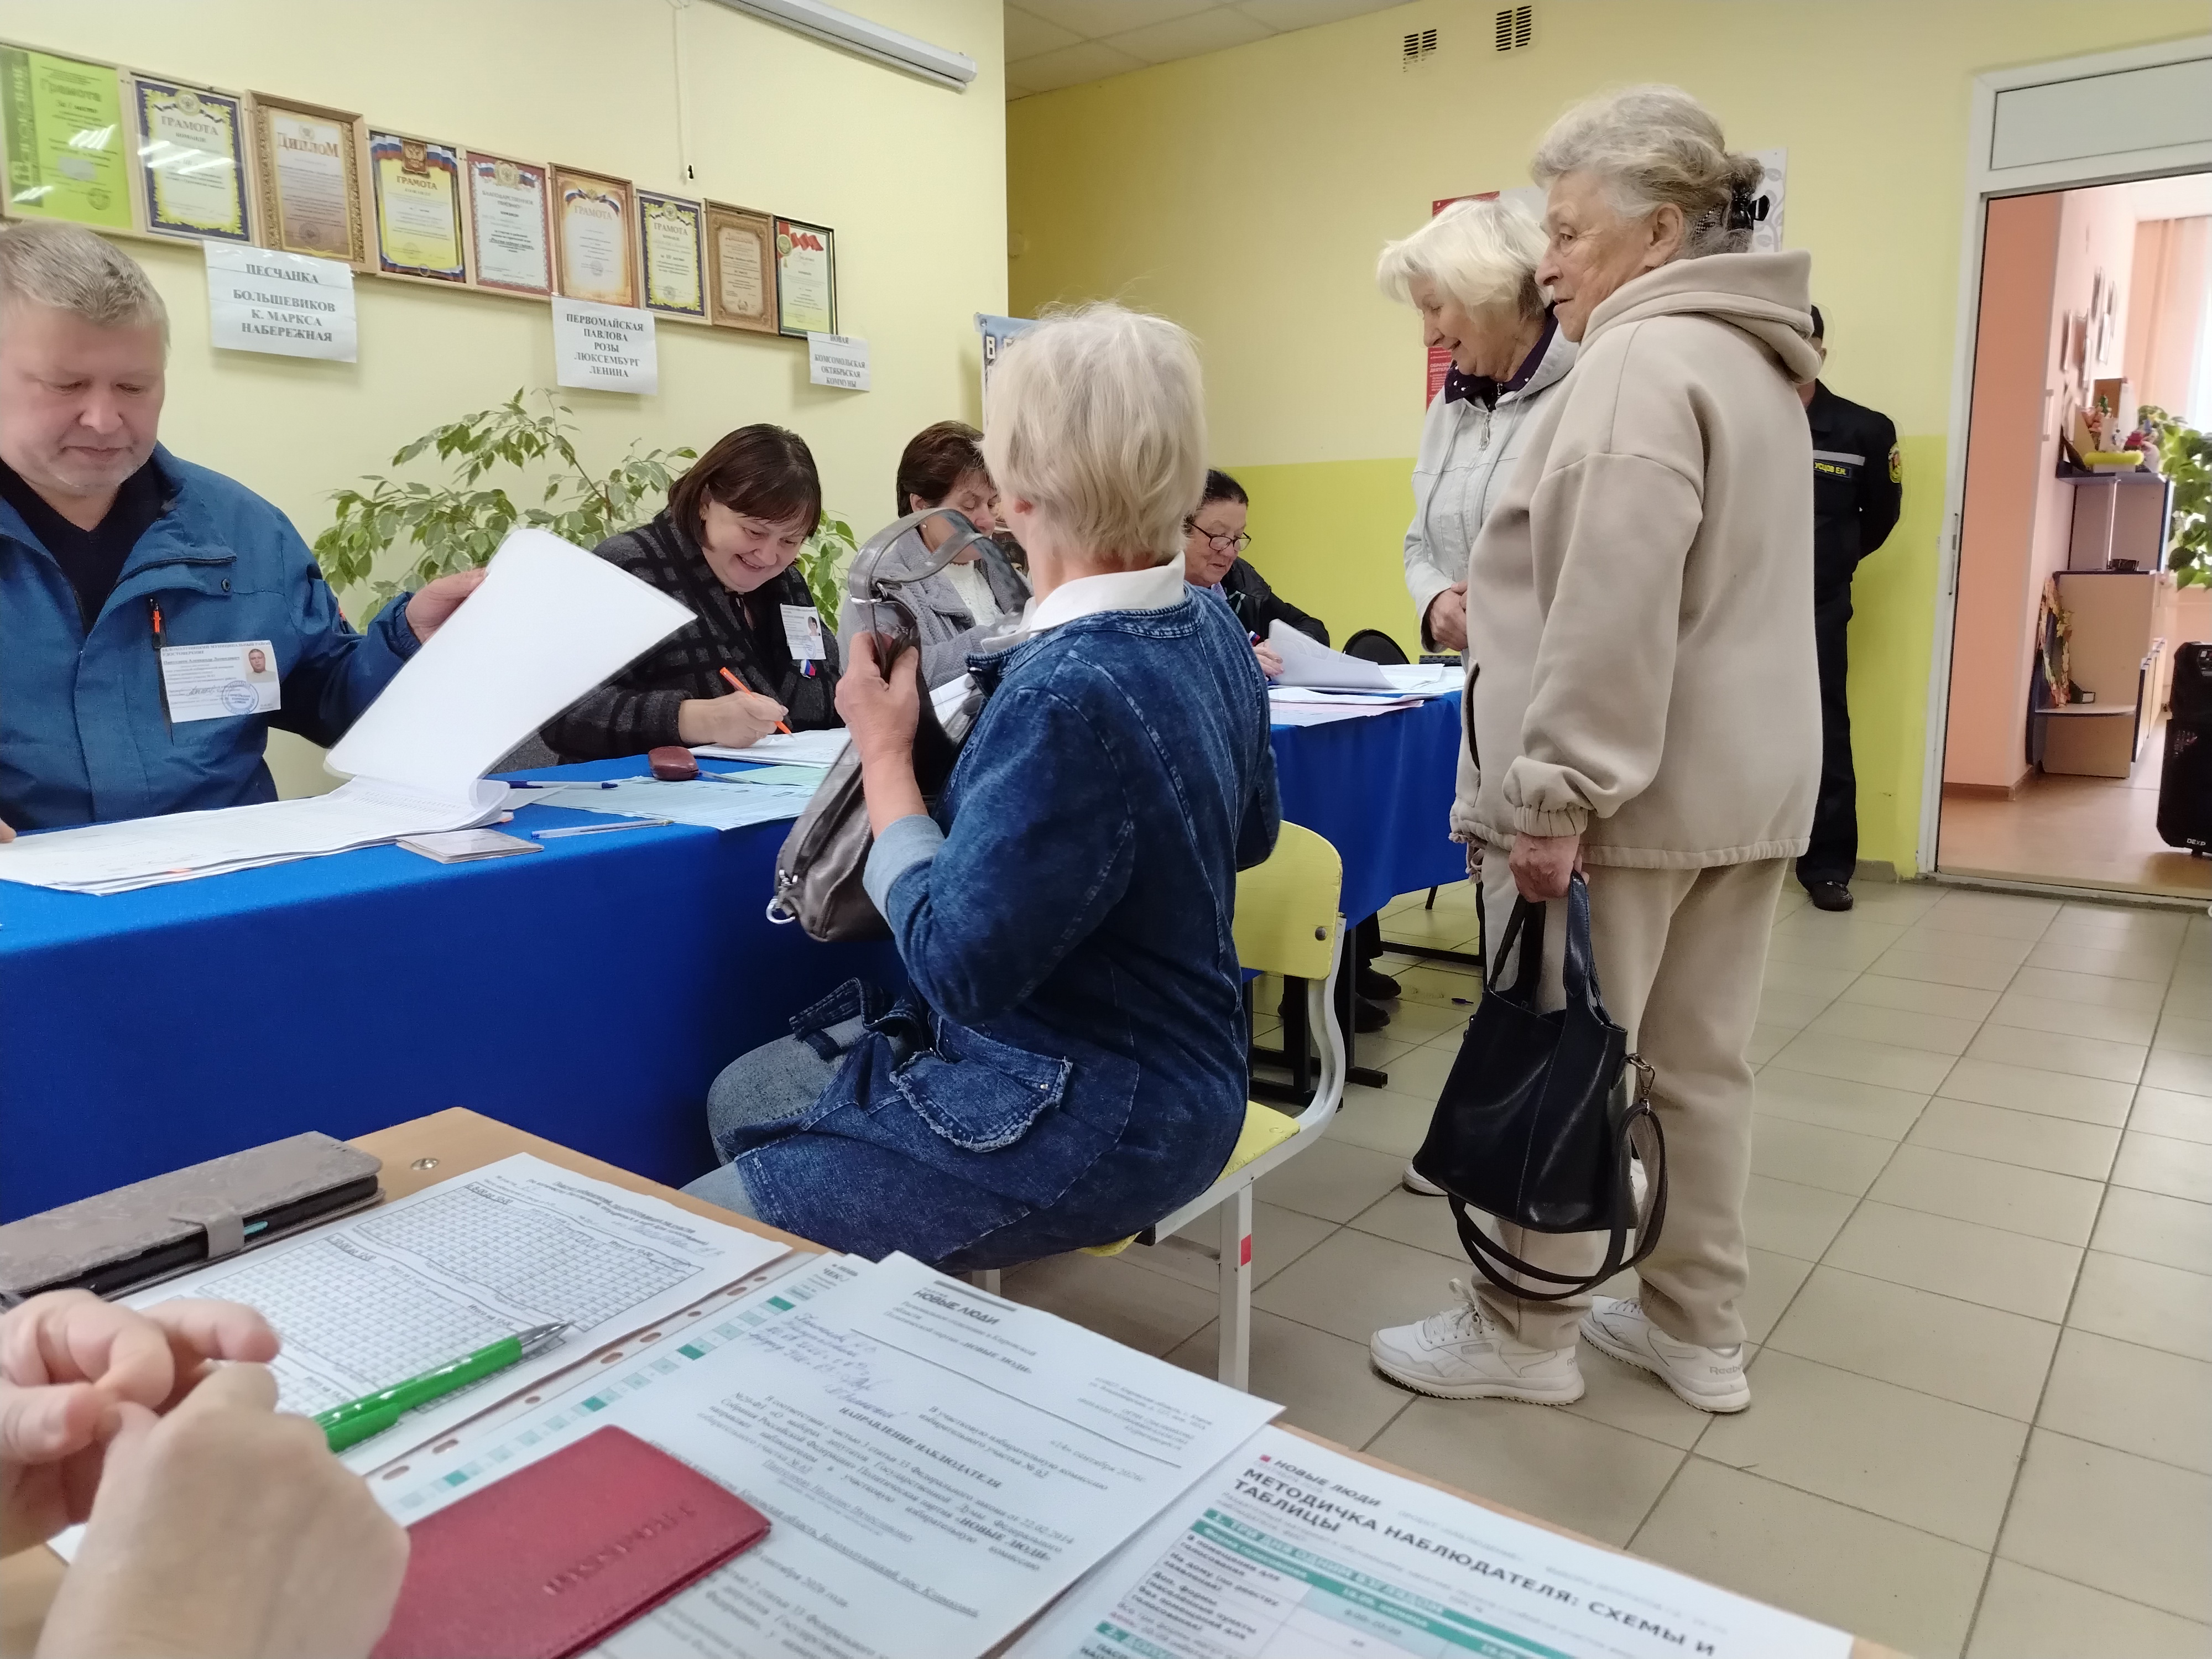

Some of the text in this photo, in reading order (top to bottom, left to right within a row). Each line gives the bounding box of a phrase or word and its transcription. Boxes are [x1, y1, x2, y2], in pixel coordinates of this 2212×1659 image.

[161, 116, 218, 135] ГРАМОТА
[397, 175, 438, 190] ГРАМОТА
[574, 205, 613, 221] ГРАМОТА
[654, 222, 688, 236] ГРАМОТА
[246, 263, 319, 283] ПЕСЧАНКА
[233, 289, 336, 312] БОЛЬШЕВИКОВ
[251, 309, 322, 326] К. МАРКСА
[566, 314, 644, 331] ПЕРВОМАЙСКАЯ
[242, 322, 332, 342] НАБЕРЕЖНАЯ
[584, 328, 628, 342] ПАВЛОВА
[830, 335, 849, 345] НОВАЯ
[594, 342, 619, 353] РОЗЫ
[574, 352, 640, 367] ЛЮКСЕМБУРГ
[814, 354, 865, 368] КОМСОМОЛЬСКАЯ
[589, 366, 629, 377] ЛЕНИНА
[821, 366, 860, 378] ОКТЯБРЬСКАЯ
[826, 377, 857, 388] КОММУНЫ
[914, 1290, 999, 1324] НОВЫЕ ЛЮДИ
[959, 1342, 998, 1358] «НОВЫЕ
[998, 1356, 1031, 1373] ЛЮДИ»
[839, 1407, 1001, 1488] НАПРАВЛЕНИЕ НАБЛЮДАТЕЛЯ
[919, 1414, 985, 1448] избирательного
[984, 1446, 1022, 1465] участка
[1021, 1462, 1035, 1471] №
[935, 1411, 988, 1437] участковую
[988, 1436, 1058, 1469] избирательную
[1058, 1468, 1108, 1490] комиссию
[772, 1400, 825, 1426] соответствии
[868, 1446, 897, 1463] статьи
[910, 1466, 973, 1501] Федерального
[974, 1499, 1006, 1516] закона
[1072, 1451, 1115, 1472] сентября
[759, 1432, 818, 1463] наблюдателем
[841, 1474, 895, 1503] участковую
[905, 1506, 977, 1543] избирательную
[874, 1462, 957, 1503] Государственной
[1274, 1460, 1328, 1486] НОВЫЕ
[1330, 1484, 1381, 1506] ЛЮДИ
[857, 1466, 923, 1501] Политическая
[955, 1517, 1005, 1541] «НОВЫЕ
[1005, 1539, 1050, 1561] ЛЮДИ»
[1234, 1479, 1342, 1532] ТАБЛИЦЫ
[1170, 1552, 1184, 1563] На
[1185, 1562, 1213, 1578] дому
[1181, 1542, 1254, 1576] голосования
[1188, 1540, 1265, 1571] помещении
[1258, 1570, 1280, 1581] для
[1243, 1468, 1376, 1530] МЕТОДИЧКА
[1385, 1527, 1577, 1604] НАБЛЮДАТЕЛЯ:
[1588, 1601, 1686, 1645] СХЕМЫ
[1695, 1640, 1715, 1656] И
[1178, 1585, 1217, 1606] формы
